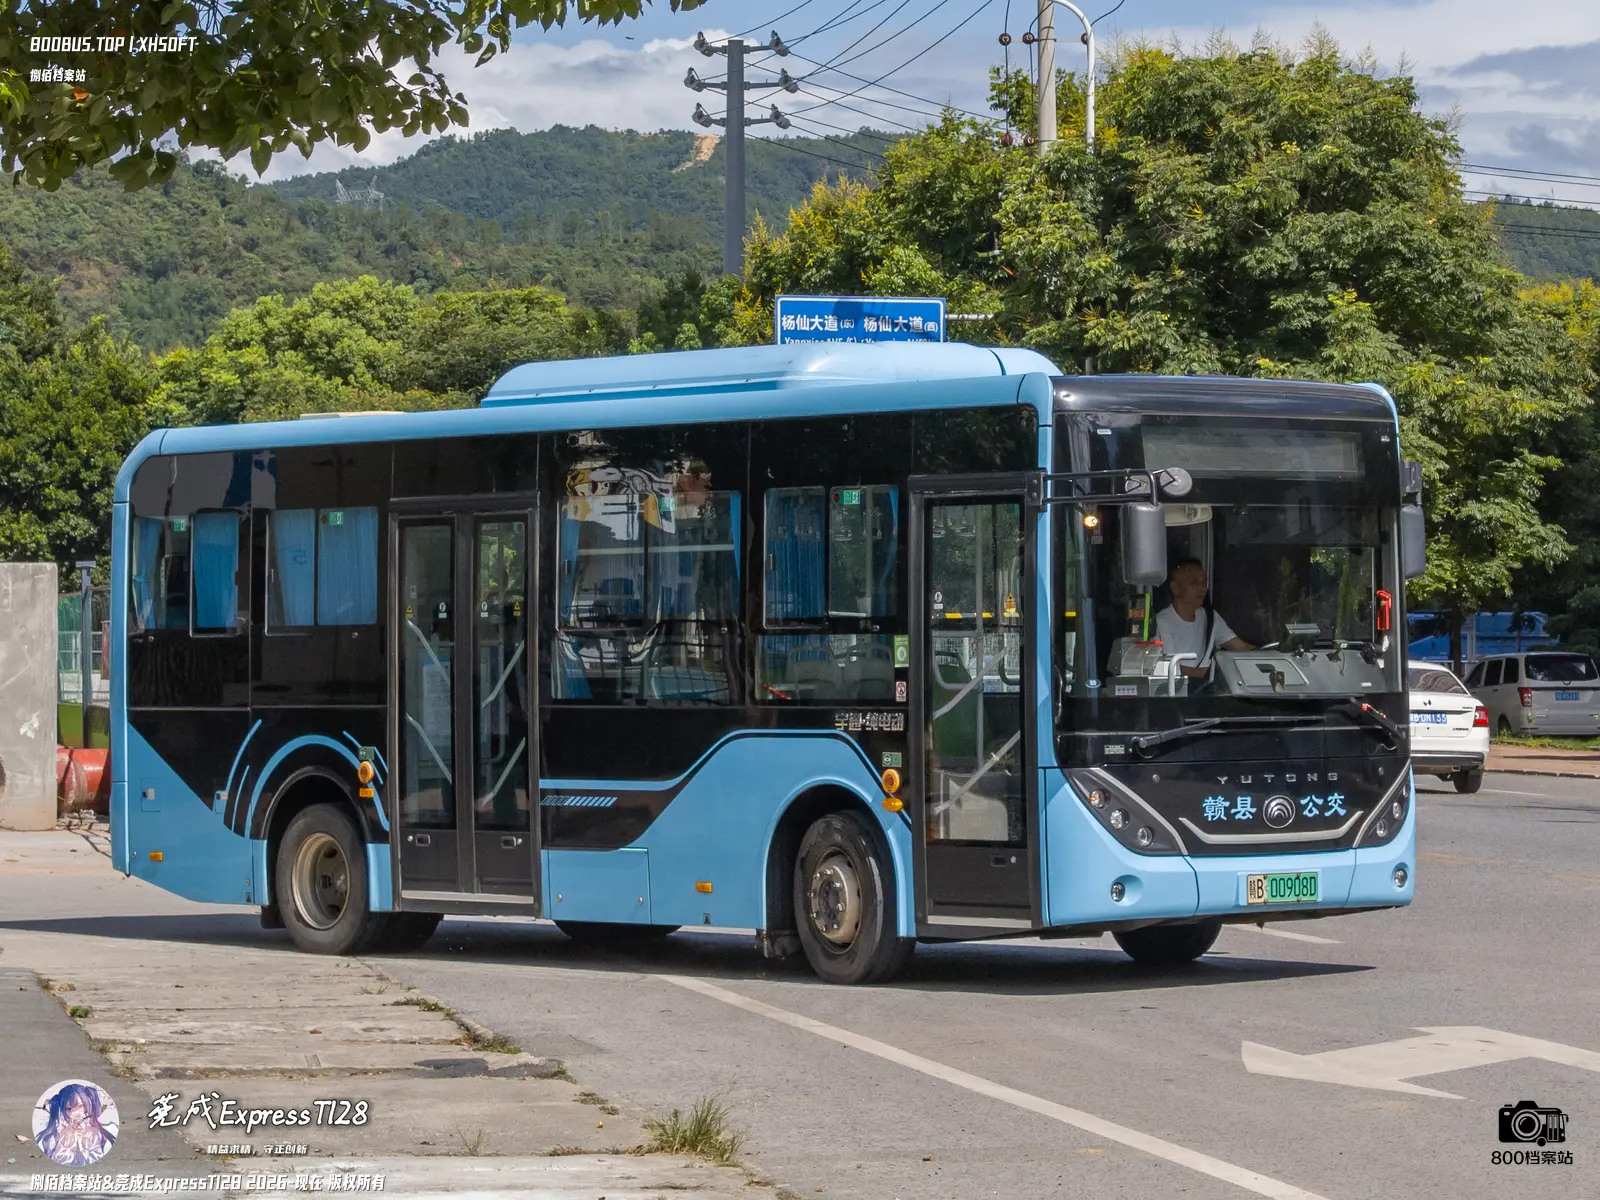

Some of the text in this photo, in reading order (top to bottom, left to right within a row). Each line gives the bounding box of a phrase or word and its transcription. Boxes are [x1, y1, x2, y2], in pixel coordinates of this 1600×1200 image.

[1217, 772, 1338, 784] YUTONG
[1202, 793, 1347, 821] 赣县 公交
